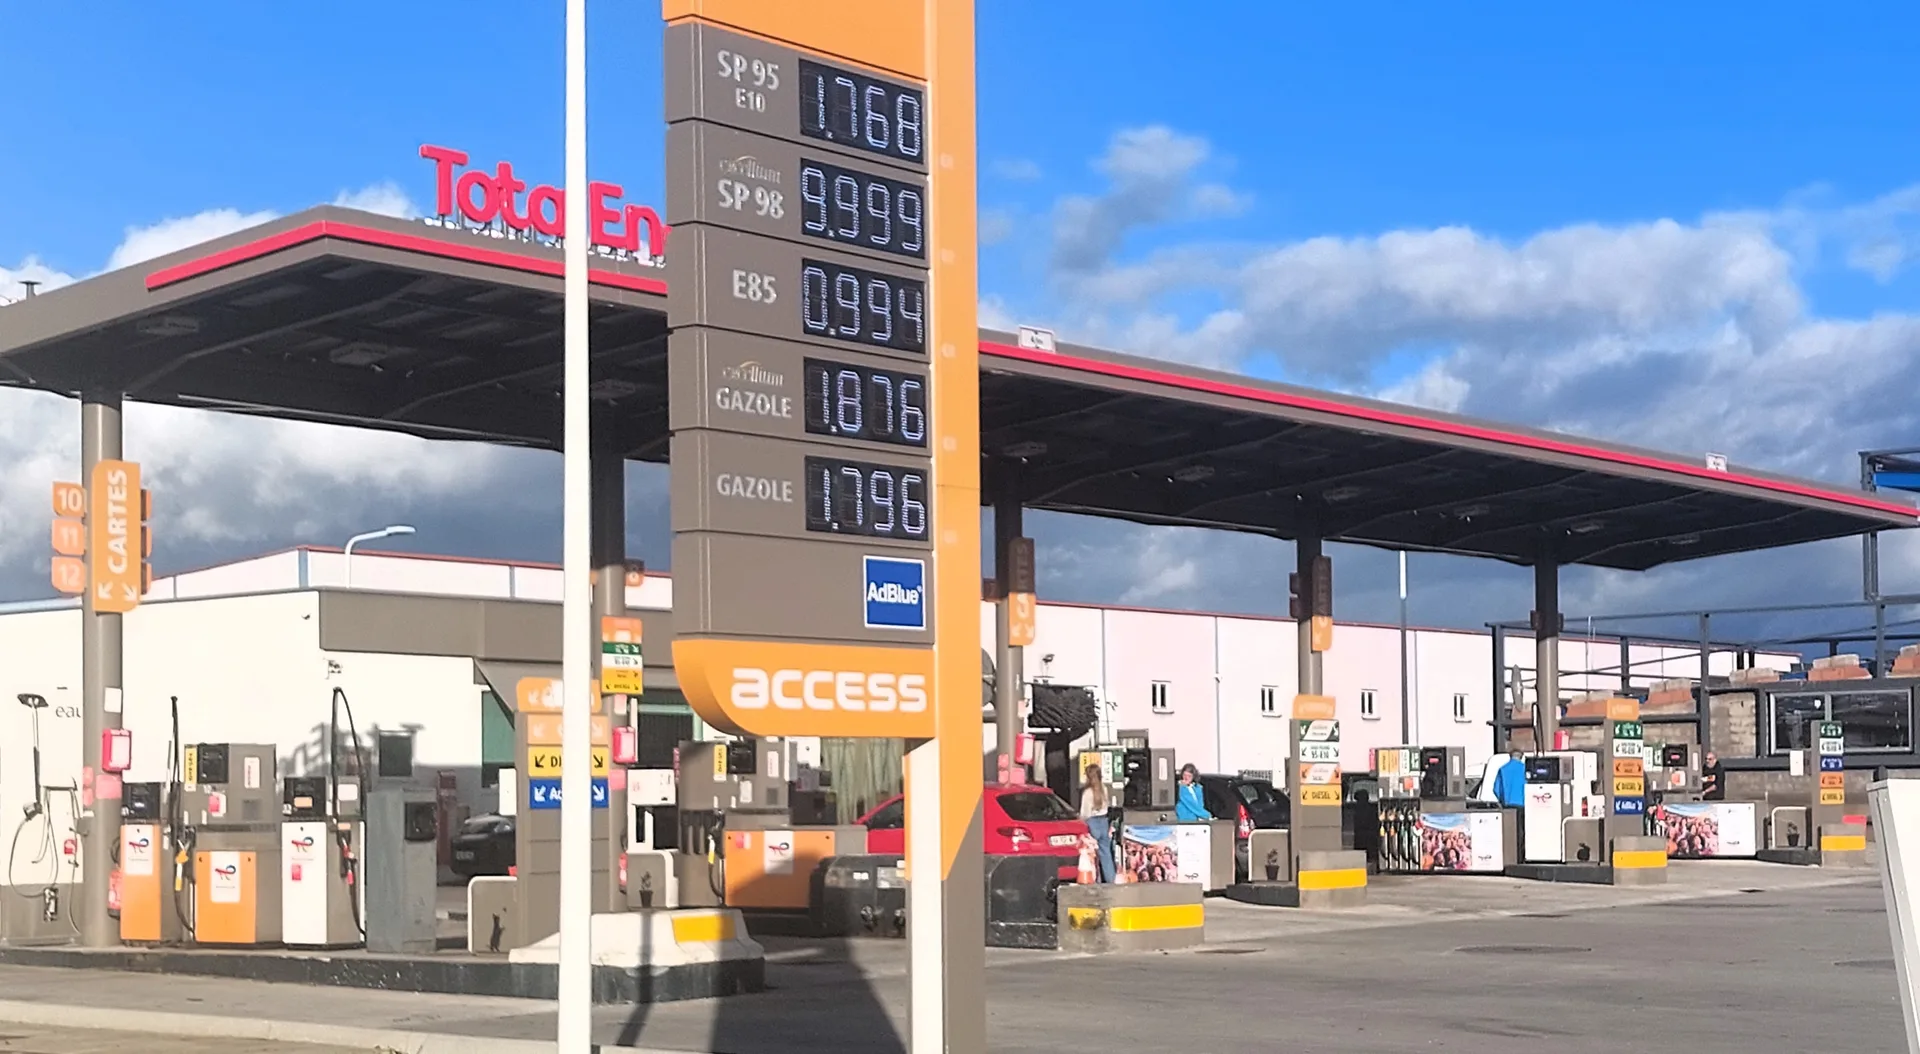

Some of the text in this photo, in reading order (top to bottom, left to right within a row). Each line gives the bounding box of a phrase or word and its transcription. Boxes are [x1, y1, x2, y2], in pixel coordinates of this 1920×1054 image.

[717, 50, 780, 90] SP 95
[735, 90, 766, 113] E10
[814, 74, 923, 157] 1.768
[419, 144, 672, 256] TotaEn
[717, 179, 785, 220] SP 98
[801, 167, 923, 251] 9.999
[732, 269, 778, 304] E85
[803, 266, 924, 344] 0.994
[716, 387, 793, 419] GAZOLE
[821, 369, 926, 441] 1.876
[57, 487, 83, 512] 10
[716, 474, 794, 502] GAZOLE
[822, 466, 927, 535] 1.796
[60, 526, 79, 548] 11
[107, 469, 128, 574] CARTES
[58, 564, 81, 587] 12
